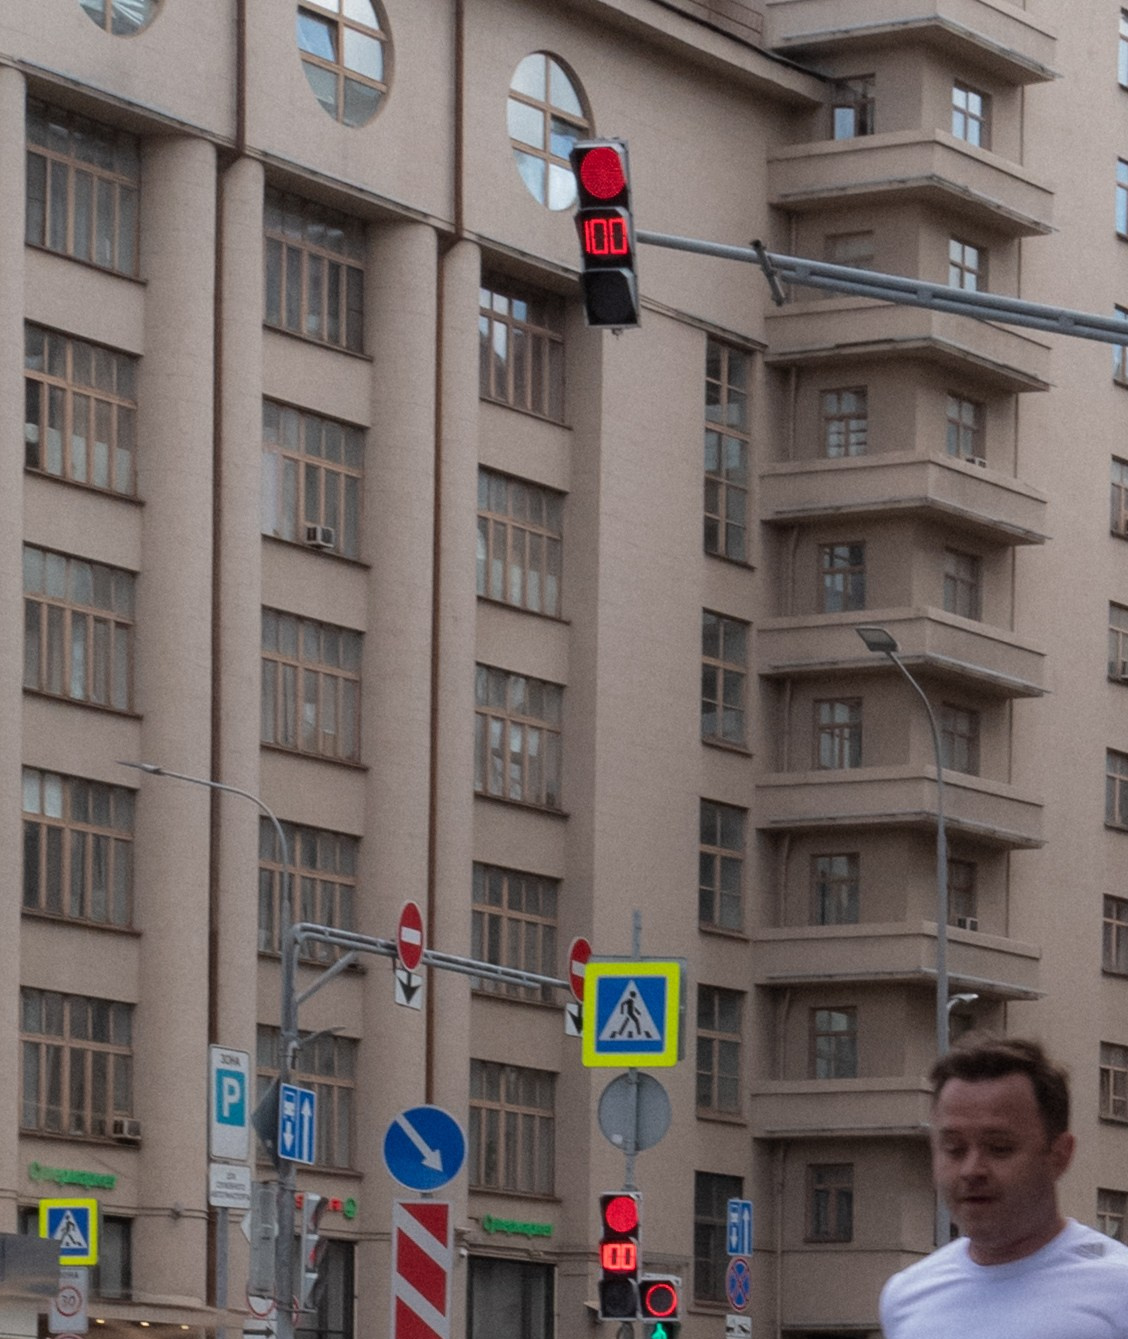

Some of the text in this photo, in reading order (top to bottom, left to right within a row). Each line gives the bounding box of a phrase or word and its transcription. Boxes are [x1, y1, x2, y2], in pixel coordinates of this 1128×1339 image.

[584, 217, 628, 255] 100
[220, 1053, 240, 1067] ЗОНА
[222, 1077, 240, 1118] P
[61, 1294, 76, 1307] 30
